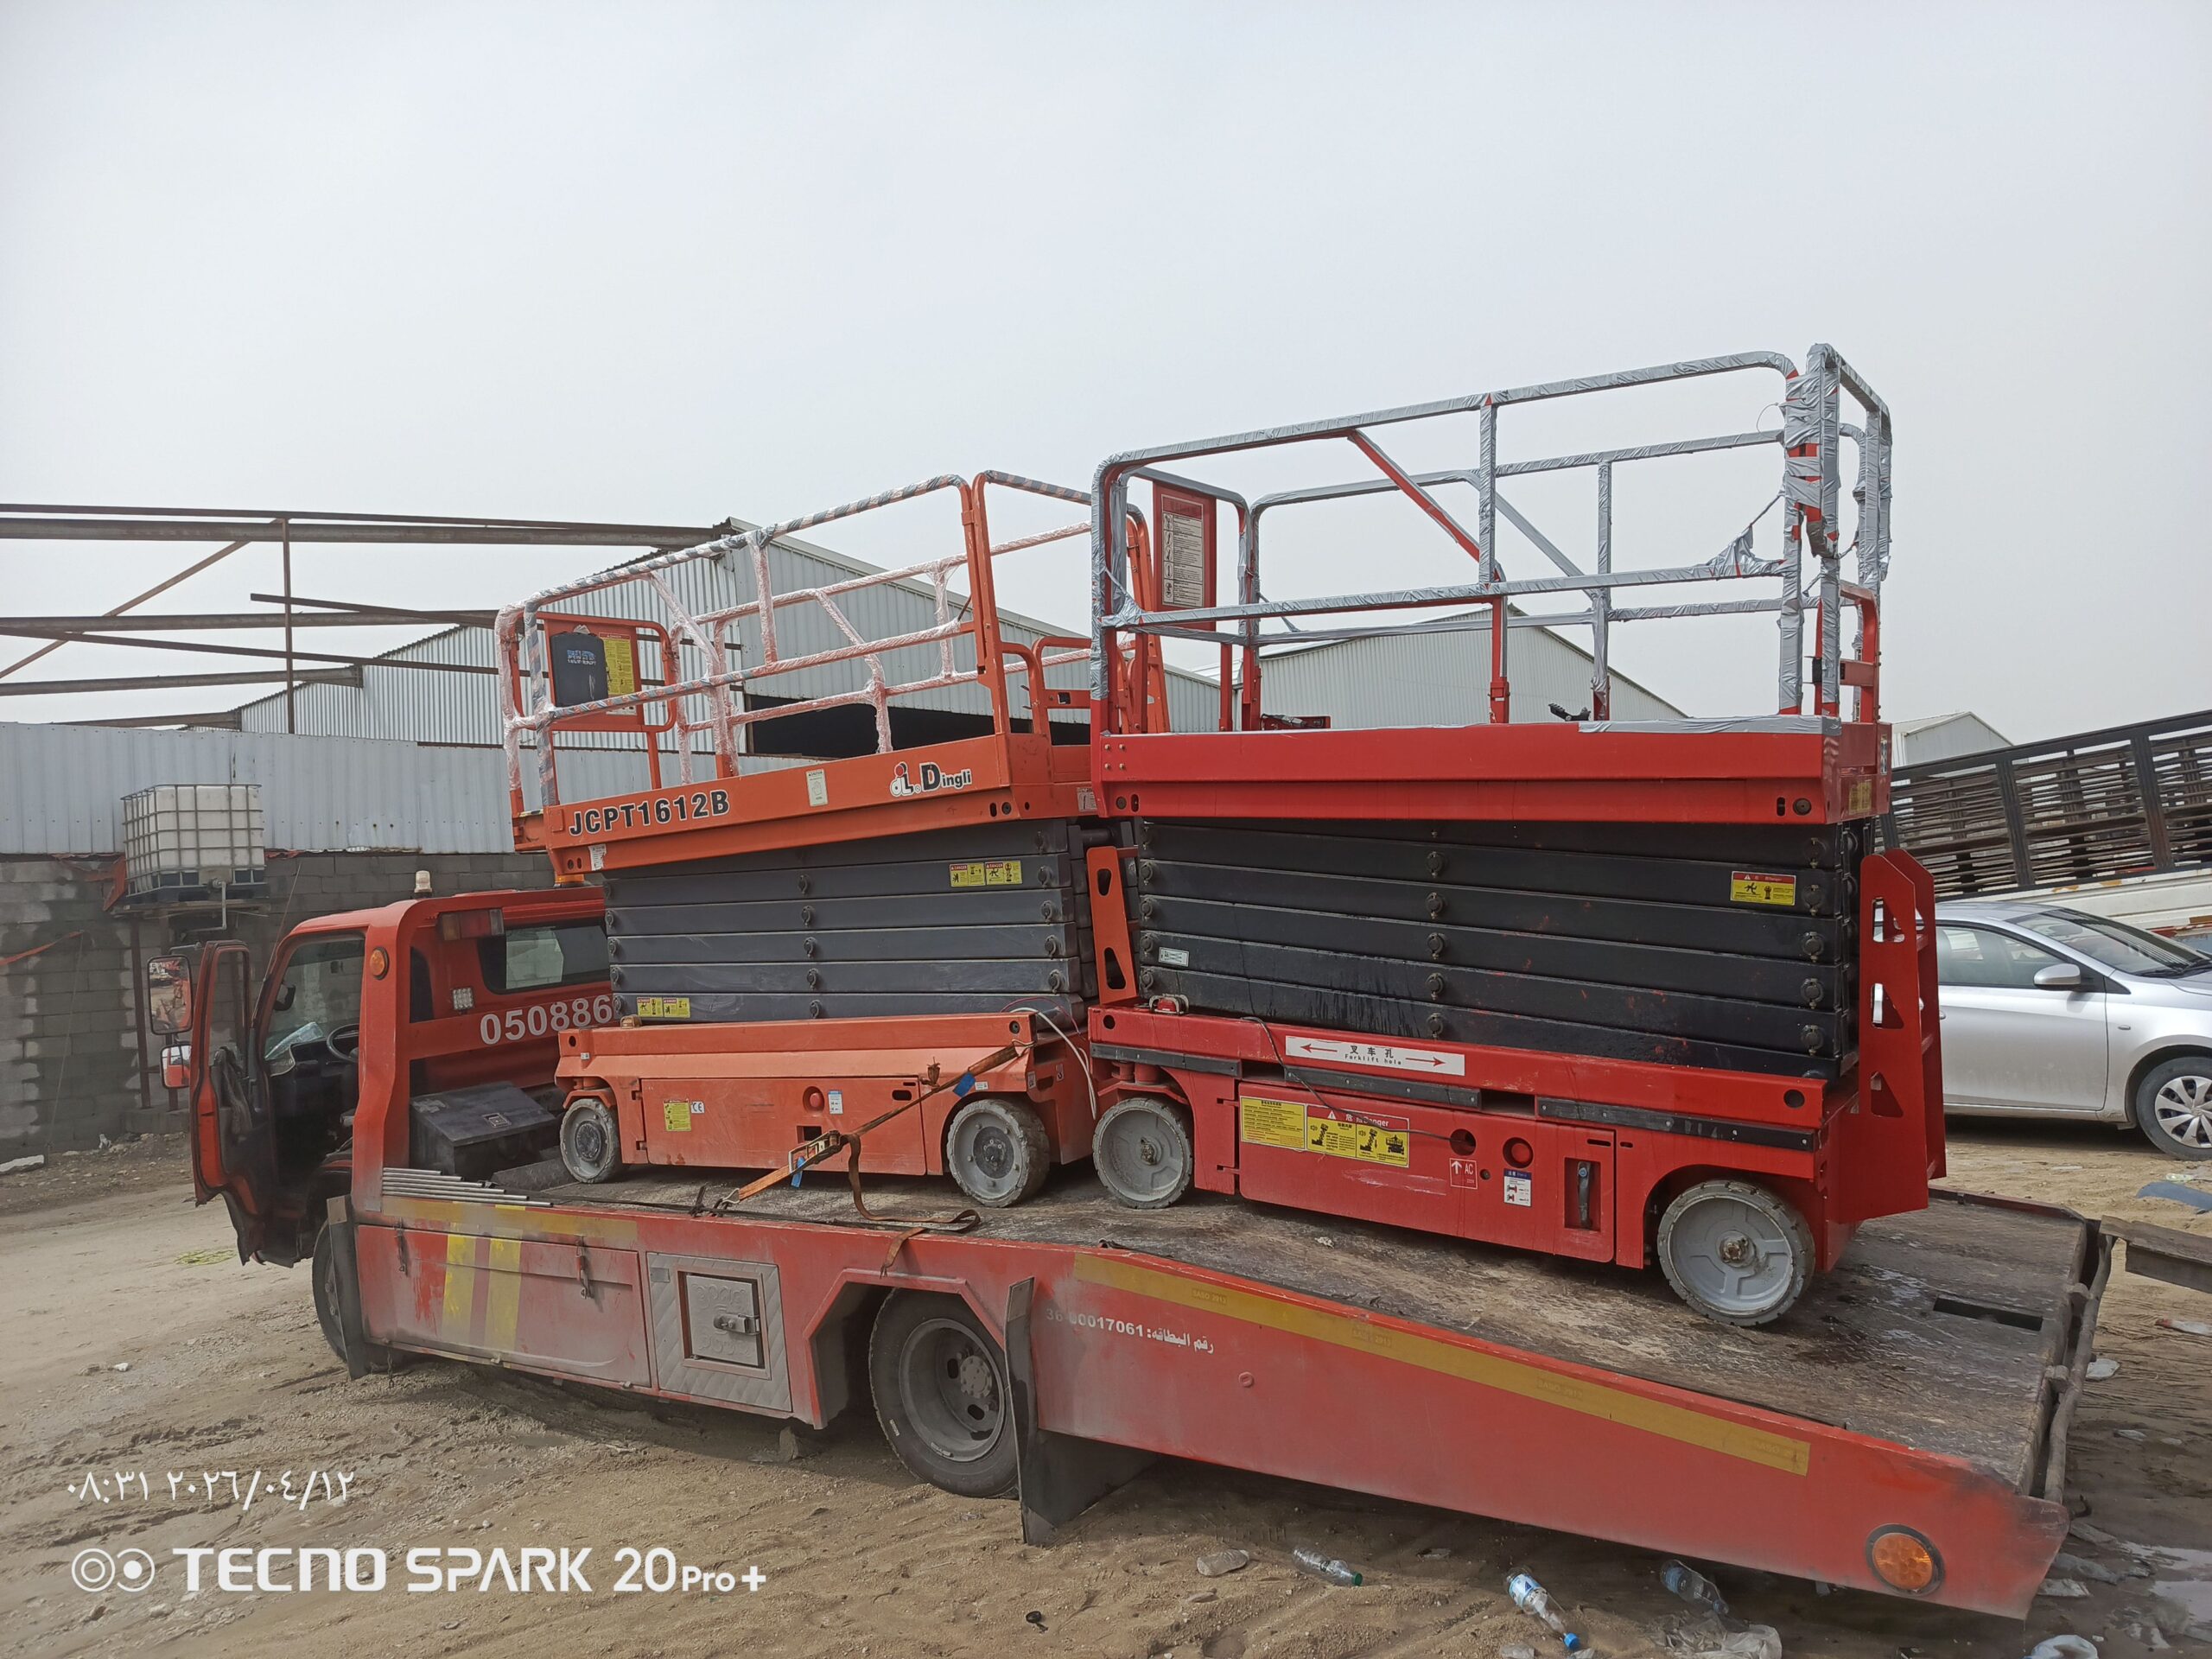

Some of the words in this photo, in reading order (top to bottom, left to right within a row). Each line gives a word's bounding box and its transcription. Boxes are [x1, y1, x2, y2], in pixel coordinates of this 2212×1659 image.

[919, 762, 972, 791] Dingli
[569, 789, 730, 836] JCPT1612B
[480, 995, 613, 1045] 050886
[1350, 1045, 1394, 1058] 叉车孔
[693, 1103, 702, 1112] CE
[1465, 1163, 1474, 1175] AC
